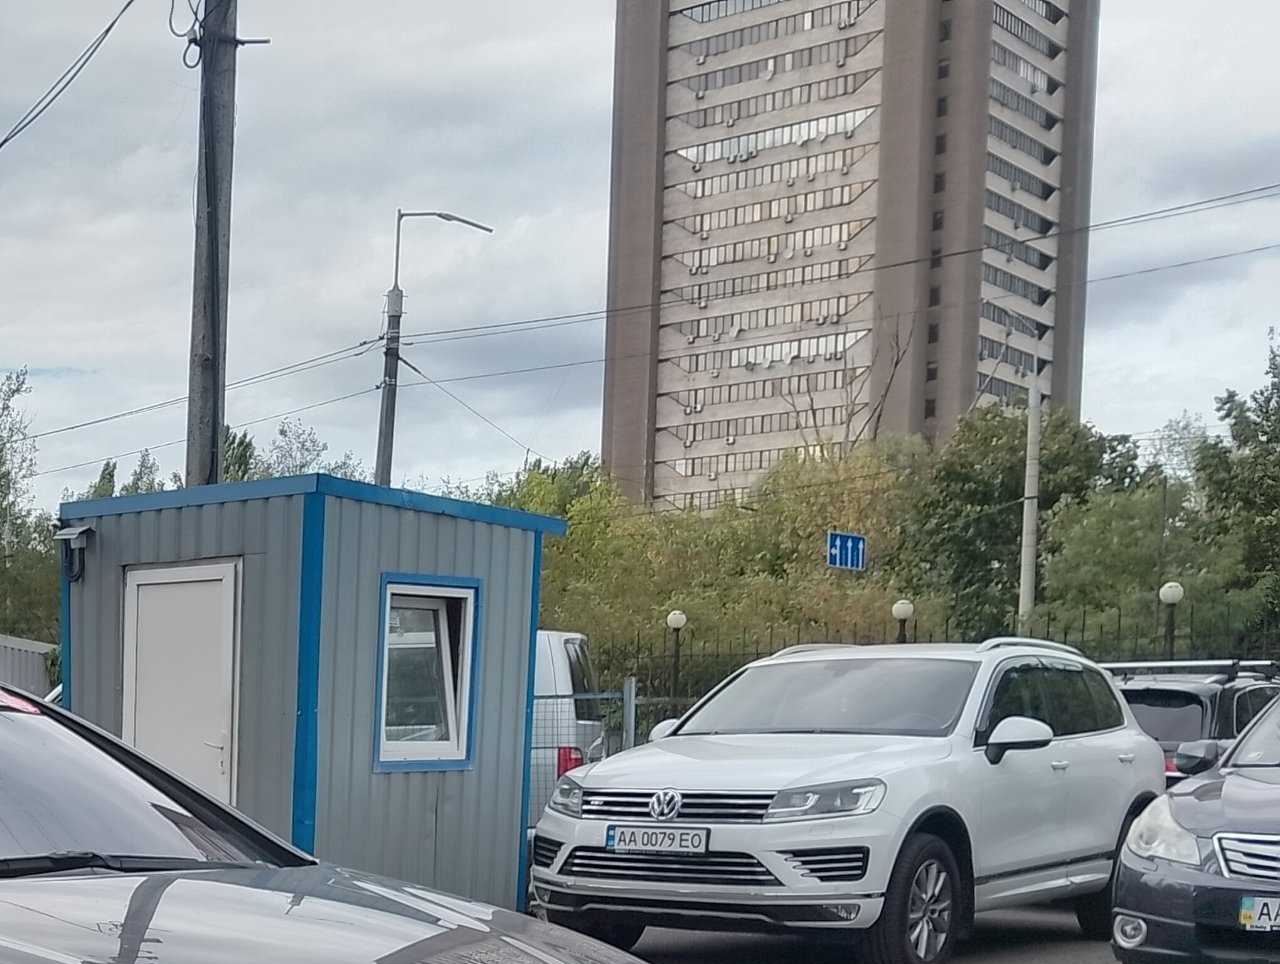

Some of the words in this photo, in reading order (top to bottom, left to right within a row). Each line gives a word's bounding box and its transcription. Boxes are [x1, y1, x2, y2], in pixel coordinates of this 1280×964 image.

[617, 831, 637, 847] AA
[641, 831, 675, 847] 0079
[679, 832, 702, 848] EO
